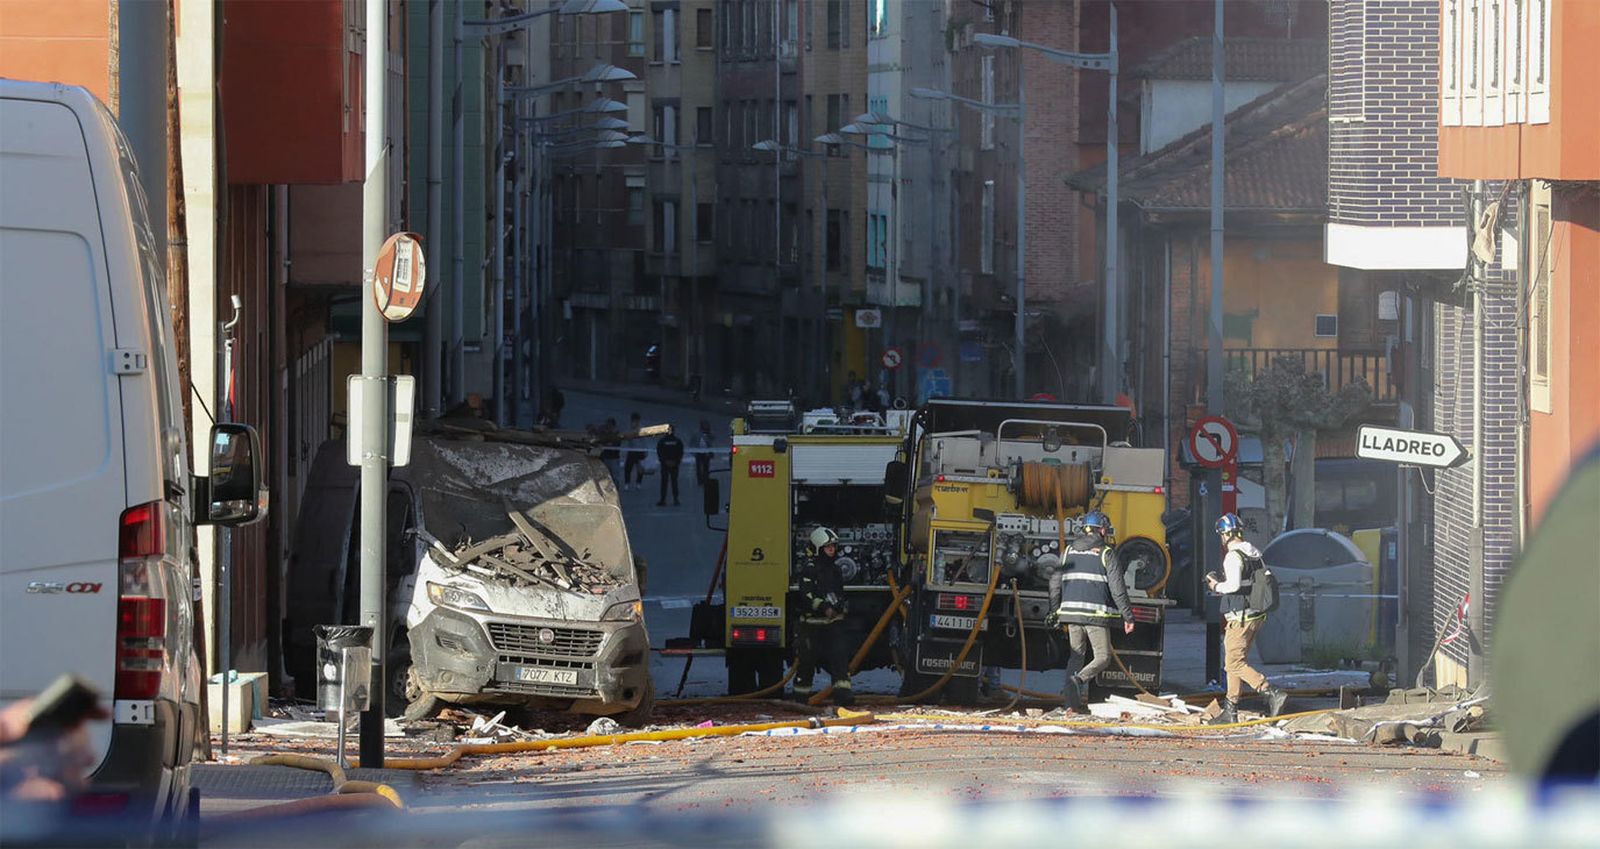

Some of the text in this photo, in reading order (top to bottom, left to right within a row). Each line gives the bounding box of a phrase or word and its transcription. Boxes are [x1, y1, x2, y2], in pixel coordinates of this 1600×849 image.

[1362, 434, 1446, 457] LLADREO
[757, 464, 773, 474] 112
[65, 582, 103, 593] CDI
[736, 606, 760, 617] 3523
[937, 616, 963, 627] 4411
[922, 653, 976, 670] rosenbuer
[523, 668, 573, 683] 7077 KTZ
